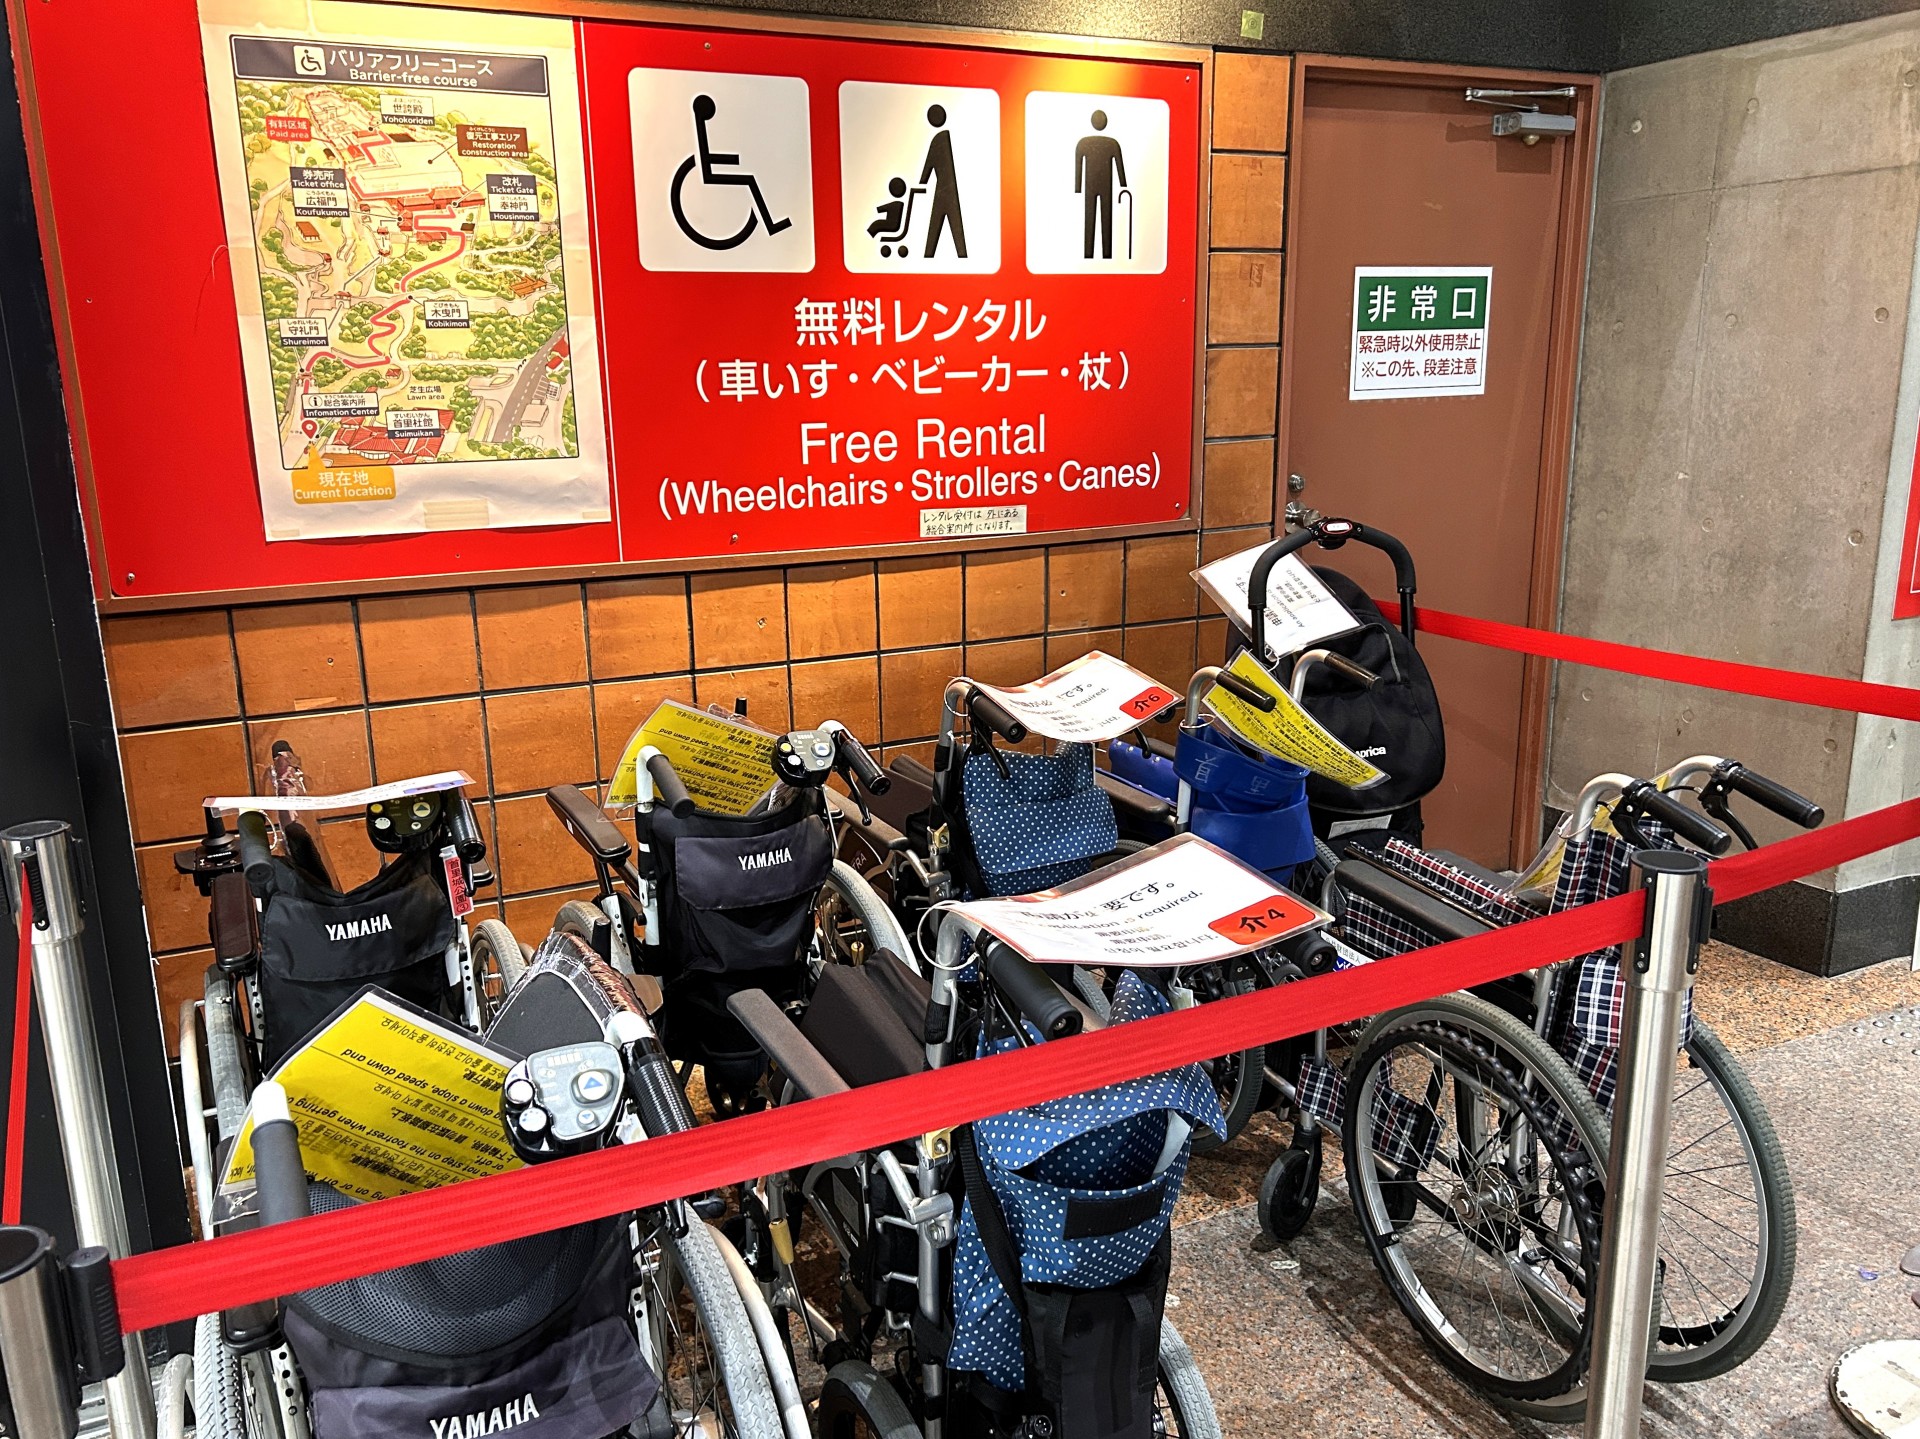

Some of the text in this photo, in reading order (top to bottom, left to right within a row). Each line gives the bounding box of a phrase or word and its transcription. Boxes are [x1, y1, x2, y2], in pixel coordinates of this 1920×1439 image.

[329, 49, 494, 76] バリアフリーコース
[349, 68, 478, 88] Barrier-free course
[268, 119, 308, 130] 有料区域
[383, 115, 434, 125] Yohokoriden
[269, 130, 288, 138] Paid
[465, 131, 521, 142] 復元工事エリア
[472, 141, 517, 150] Restoration
[461, 149, 511, 158] construction
[302, 169, 335, 181] 券売所
[292, 179, 345, 189] Ticket office
[501, 176, 522, 187] 改札
[490, 186, 535, 195] Ticket Gate
[305, 196, 338, 207] 広福門
[295, 208, 348, 217] Koufukumon
[493, 213, 535, 221] Housinmon
[1367, 284, 1478, 323] 非常口
[428, 320, 468, 328] Kobikimon
[793, 296, 1048, 347] 無料レンタル
[288, 325, 320, 336] 守礼門
[282, 338, 327, 346] Shureimon
[1358, 332, 1482, 356] 緊急時以外使用禁止
[1360, 357, 1478, 379] ※この先、段差注意
[409, 385, 442, 394] 芝生広場
[323, 398, 367, 407] 総合案内所
[305, 408, 378, 417] Infomation Center
[394, 430, 434, 438] Suimuikan
[800, 413, 1047, 466] Free Rental
[318, 470, 369, 487] 現在地
[294, 484, 392, 501] Current location
[1133, 693, 1161, 713] 介6
[658, 728, 672, 736] and
[738, 847, 793, 871] YAMAHA
[1136, 890, 1204, 920] required.
[1238, 908, 1287, 934] 介4
[325, 913, 393, 942] YAMAHA
[340, 1048, 366, 1063] and
[367, 1059, 396, 1076] down
[396, 1068, 428, 1089] speed
[431, 1085, 459, 1106] slope,
[295, 1098, 338, 1119] getting
[468, 1102, 493, 1117] down
[337, 1115, 366, 1132] when
[365, 1129, 409, 1149] footrest
[409, 1145, 427, 1156] the
[428, 1152, 441, 1160] on
[441, 1157, 463, 1168] step
[475, 1155, 492, 1167] off.
[230, 1166, 244, 1178] lock
[462, 1166, 480, 1176] not
[355, 1187, 369, 1196] on
[429, 1392, 540, 1439] YAMAHA
